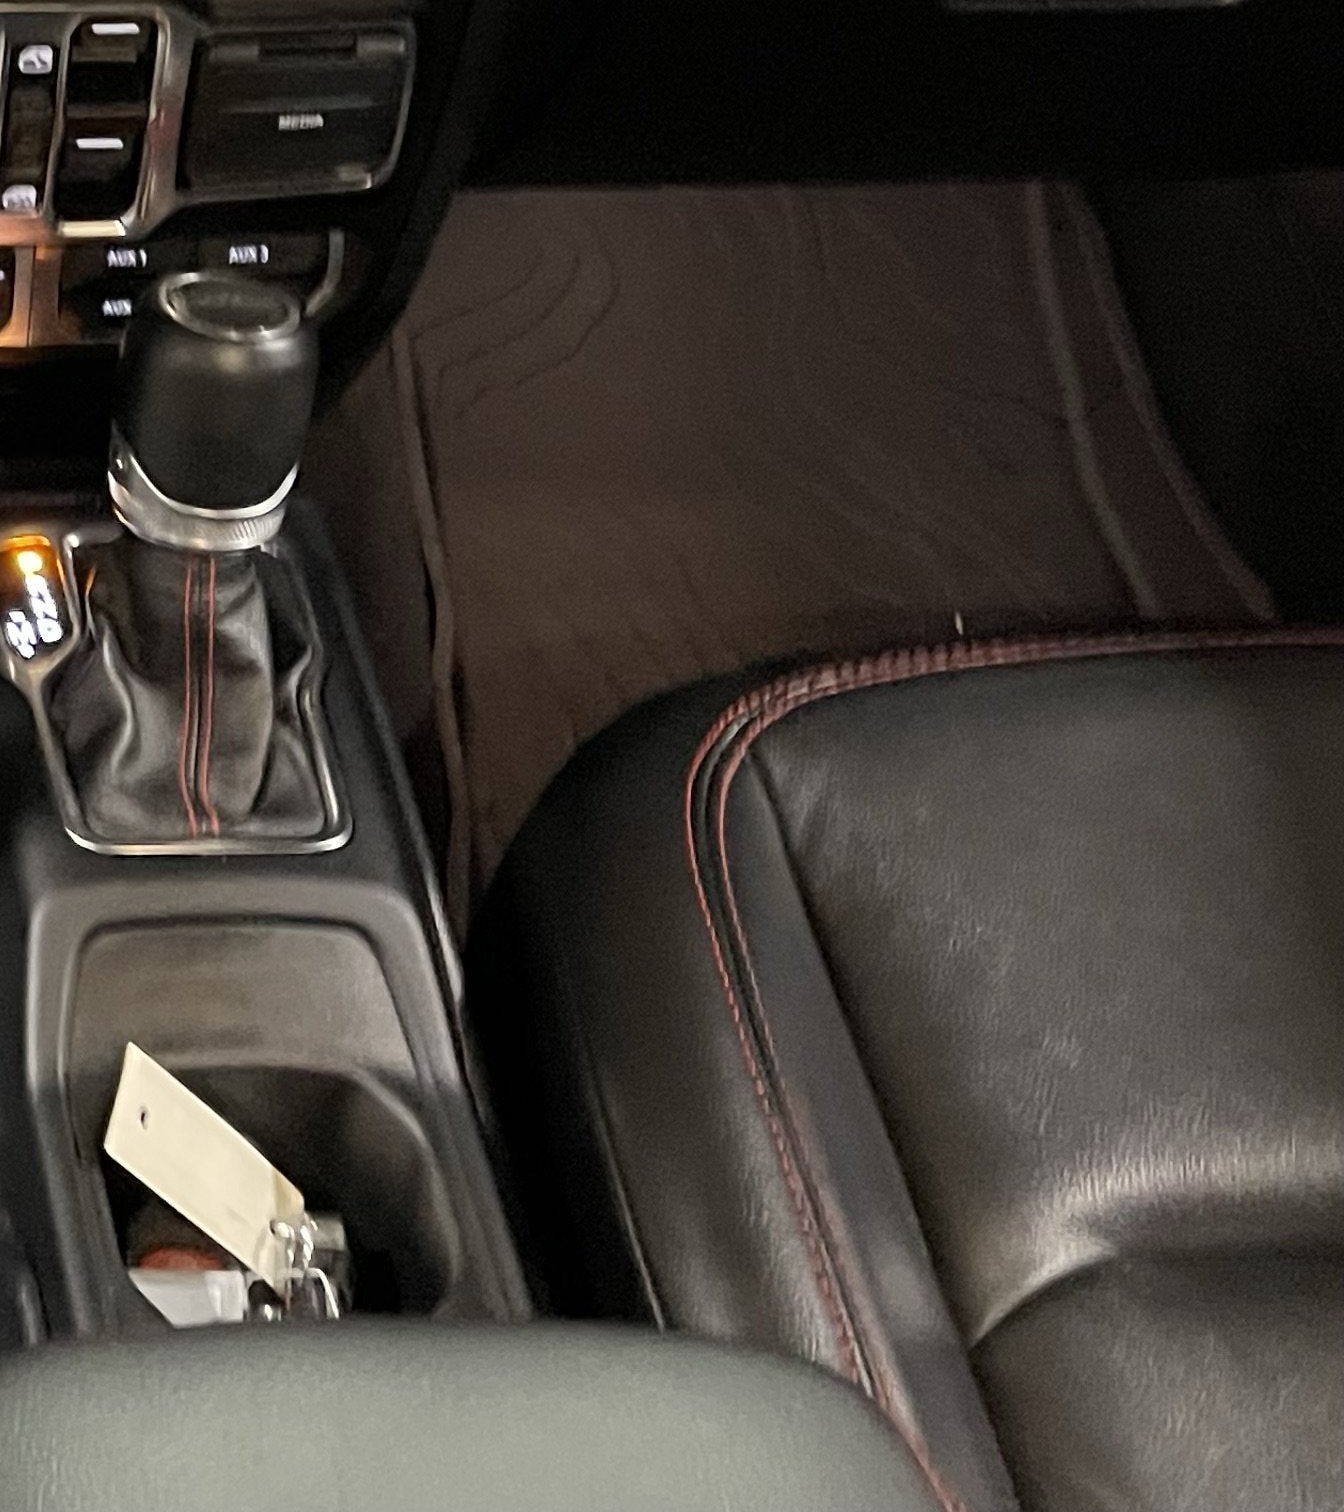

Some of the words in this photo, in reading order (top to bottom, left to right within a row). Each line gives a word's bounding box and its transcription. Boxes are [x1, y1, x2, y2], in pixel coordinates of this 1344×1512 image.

[107, 248, 137, 268] AUX
[228, 244, 258, 265] AUX
[102, 299, 132, 317] AUX
